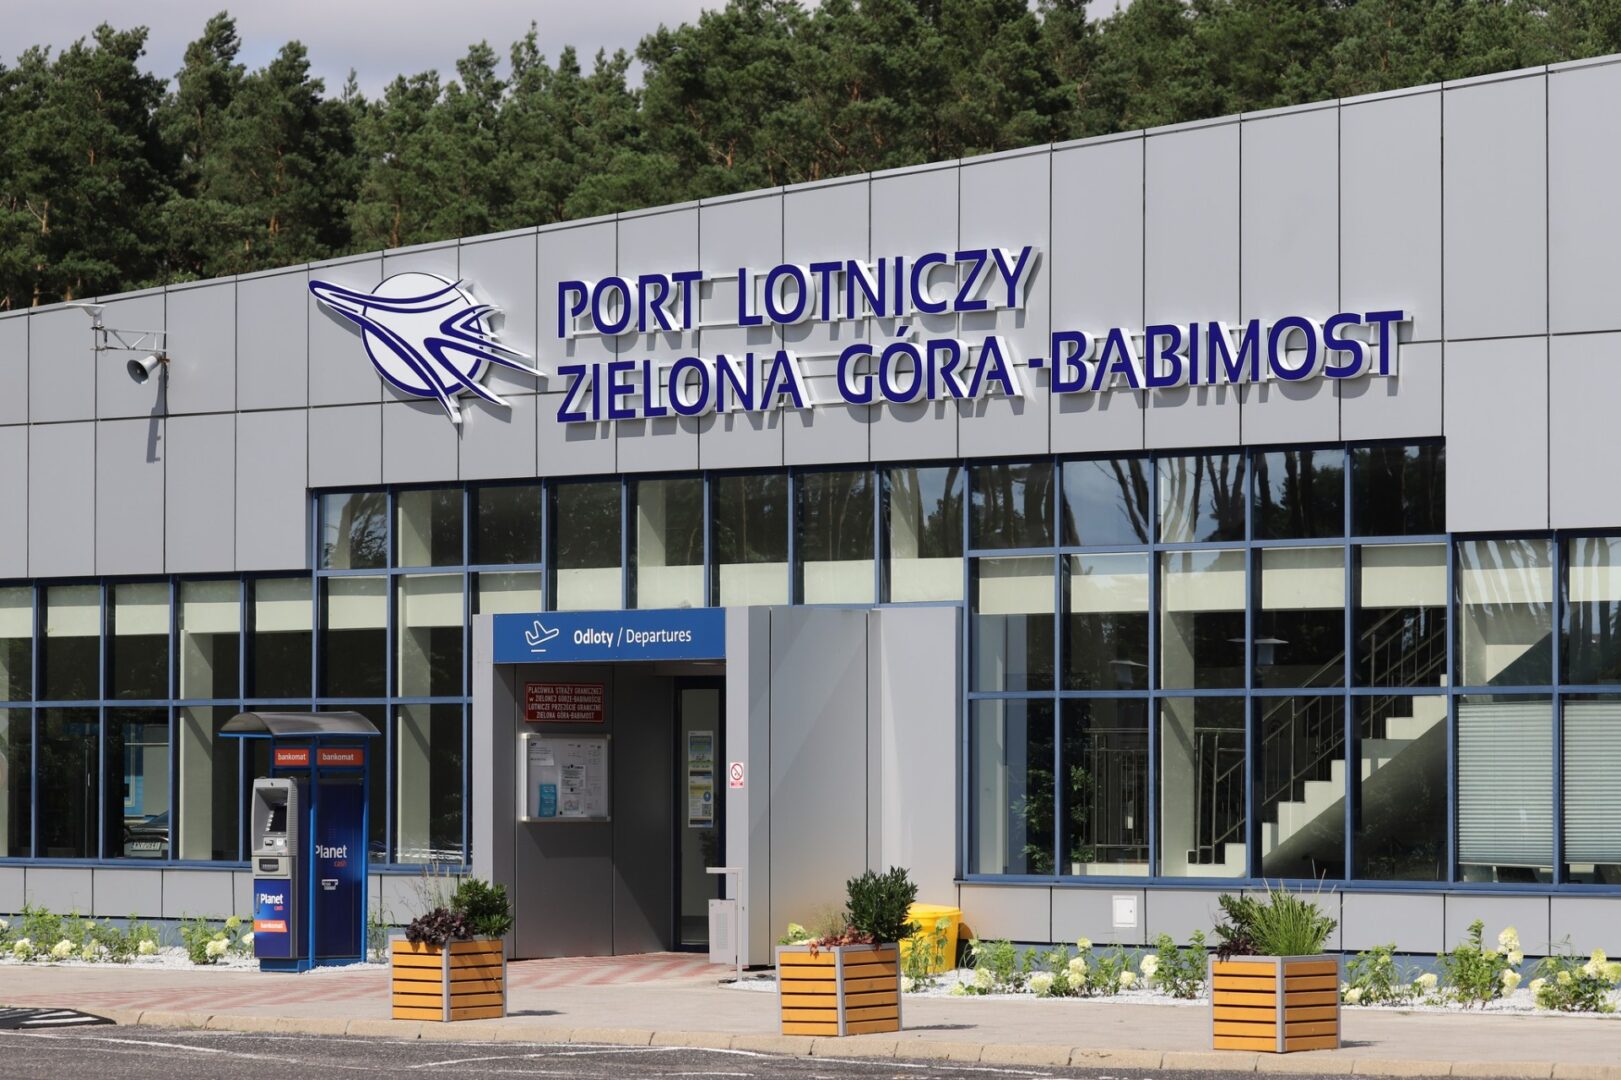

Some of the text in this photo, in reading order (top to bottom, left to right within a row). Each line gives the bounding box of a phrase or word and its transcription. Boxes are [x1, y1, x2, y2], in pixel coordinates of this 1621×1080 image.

[557, 245, 1034, 339] PORT LOTNICZY
[556, 349, 804, 423] ZIELONA
[574, 628, 614, 648] Odloty
[626, 628, 692, 647] Departures
[528, 686, 554, 694] PLACÓWKA
[555, 686, 573, 695] STRAŻY
[528, 703, 551, 711] LOTNICZE
[536, 711, 555, 719] ZIELONA
[315, 844, 347, 858] Planet
[260, 893, 283, 904] Planet
